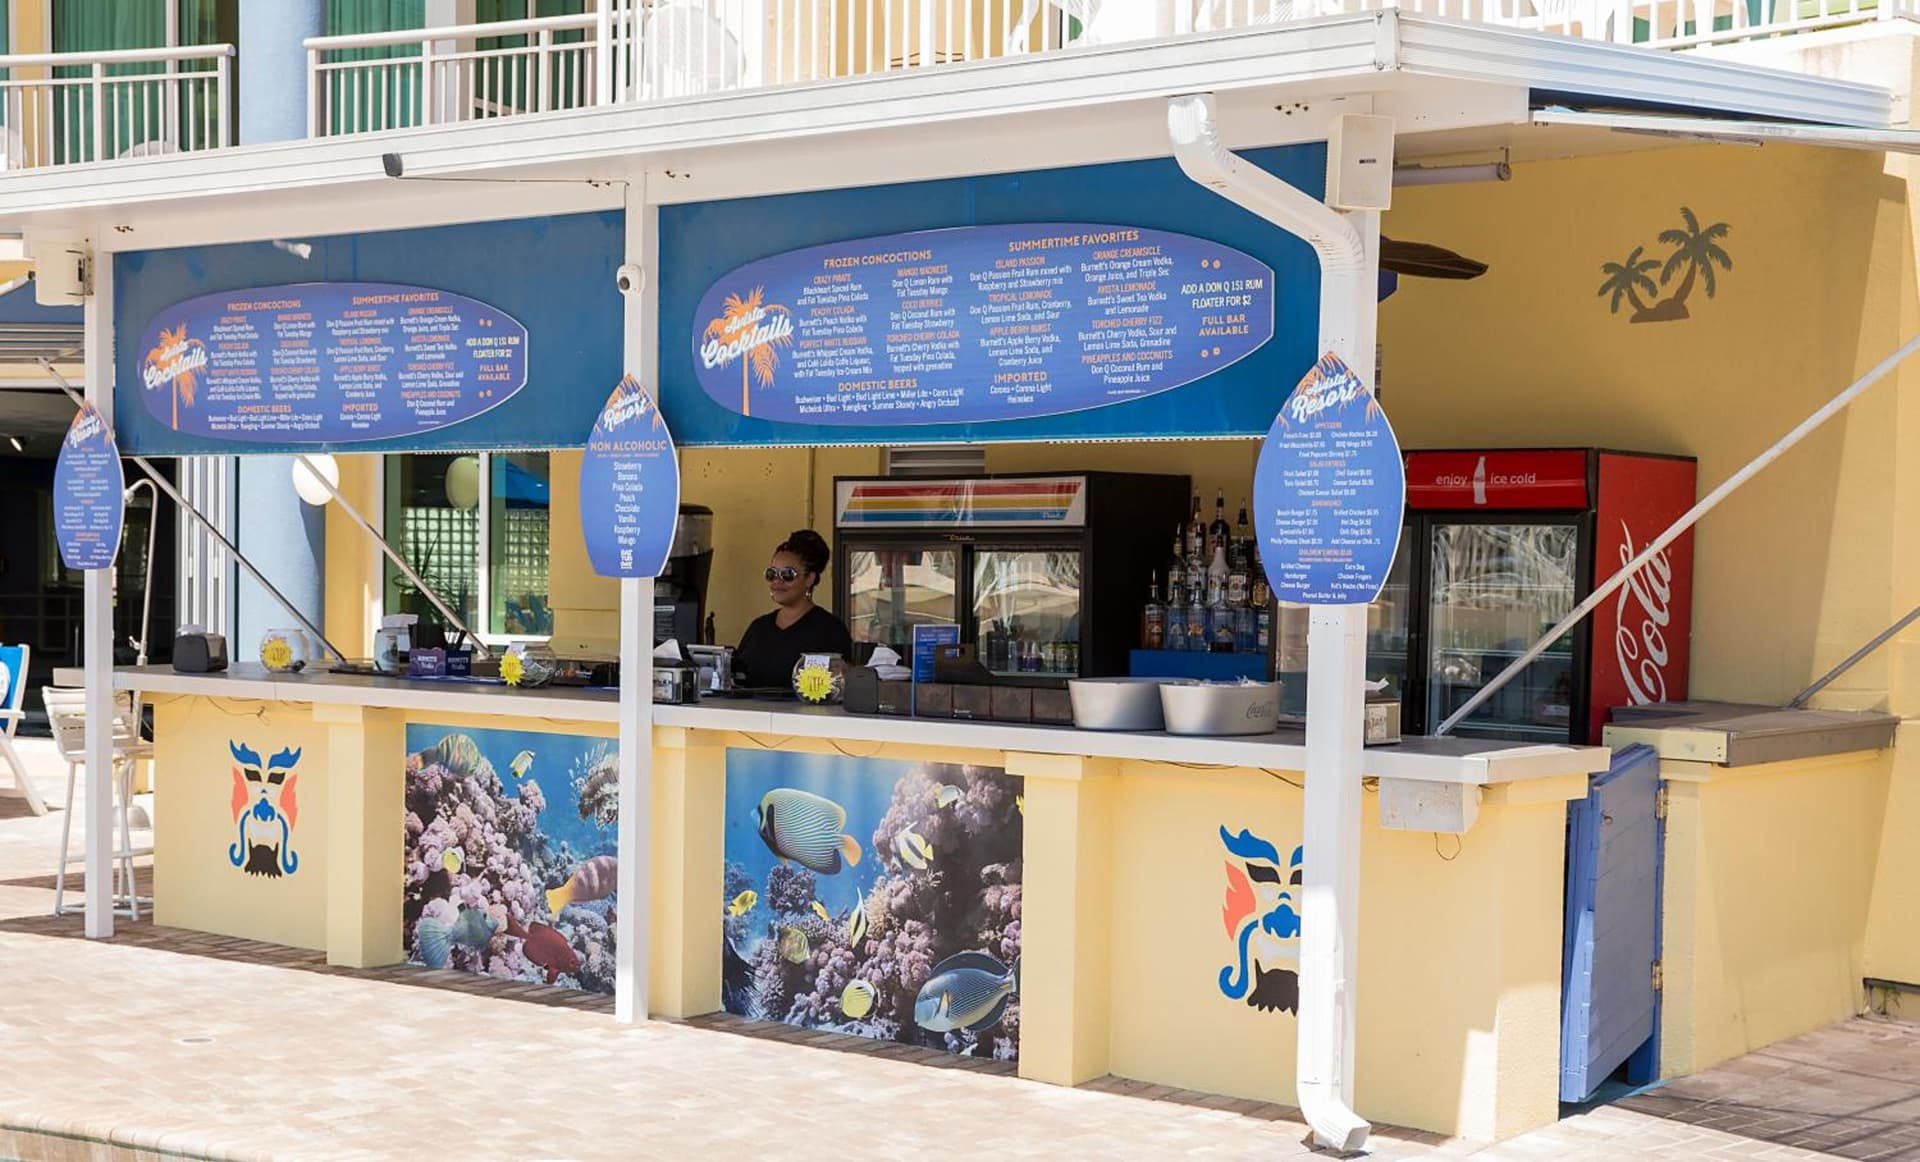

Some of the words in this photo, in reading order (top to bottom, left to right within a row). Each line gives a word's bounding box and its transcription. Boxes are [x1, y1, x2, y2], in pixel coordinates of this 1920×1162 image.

[1008, 236, 1081, 252] SUMMERTIME
[1082, 230, 1139, 246] FAVORITES
[824, 256, 860, 270] FROZEN
[862, 250, 932, 266] CONCOCTIONS
[1181, 283, 1197, 295] ADD
[1198, 283, 1205, 293] A
[1205, 281, 1222, 293] DON
[1231, 280, 1244, 291] 151
[1245, 278, 1263, 291] RUM
[1192, 296, 1225, 309] FLOATER
[1225, 295, 1241, 307] FOR
[1202, 315, 1224, 326] FULL
[1226, 313, 1246, 324] BAR
[1199, 324, 1249, 337] AVAILABLE
[700, 313, 794, 369] Cocktails
[994, 370, 1048, 384] IMPORTED
[838, 380, 887, 392] DOMESTIC
[888, 378, 918, 390] BEERS
[1291, 380, 1358, 424] Resort
[604, 398, 646, 432] Resort
[590, 441, 611, 452] NON
[613, 440, 667, 452] ALCOHOLIC
[1436, 474, 1467, 488] enjoy
[1490, 473, 1508, 485] ice
[1511, 472, 1536, 485] cold
